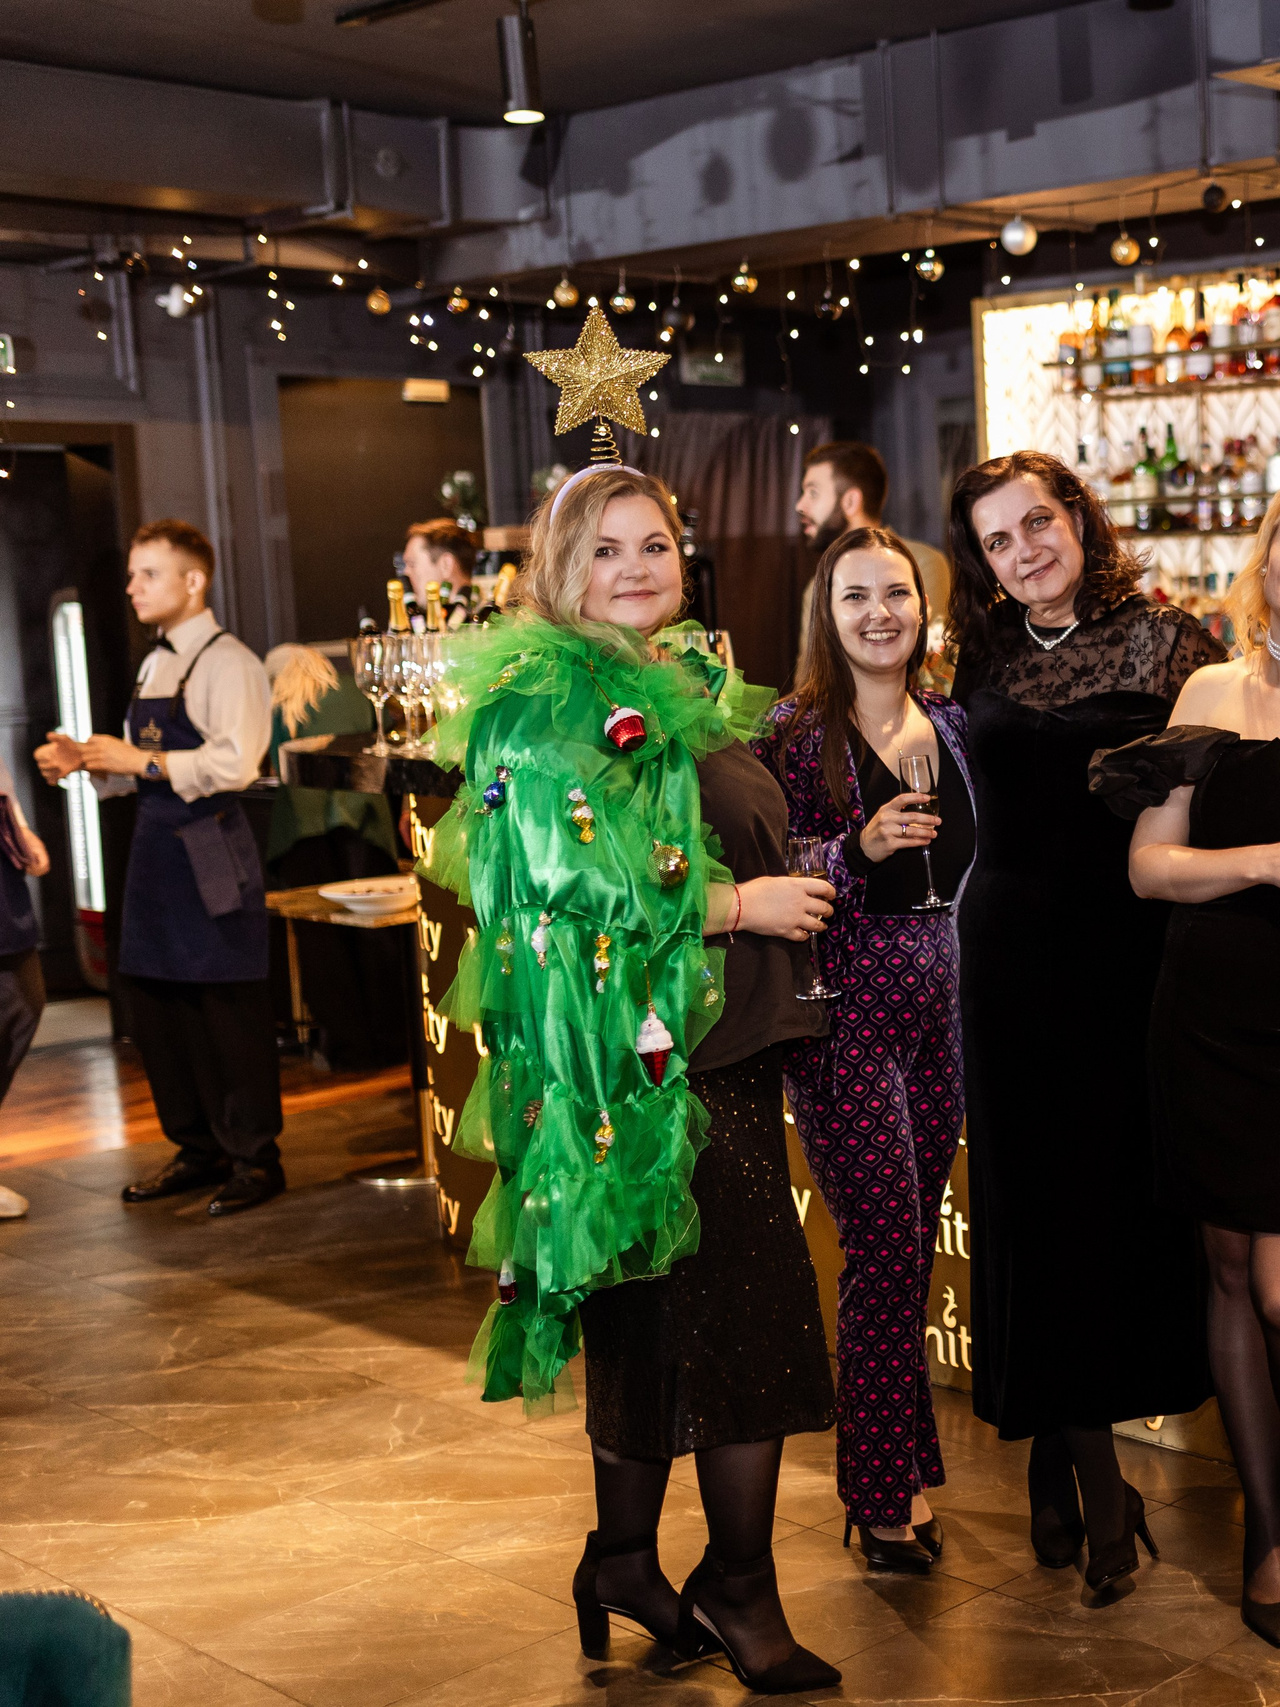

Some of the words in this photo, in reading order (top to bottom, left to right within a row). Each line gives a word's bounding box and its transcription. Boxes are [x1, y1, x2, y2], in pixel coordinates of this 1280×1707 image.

[409, 793, 436, 868] ity
[421, 972, 448, 1054] ity
[925, 1286, 972, 1372] nit
